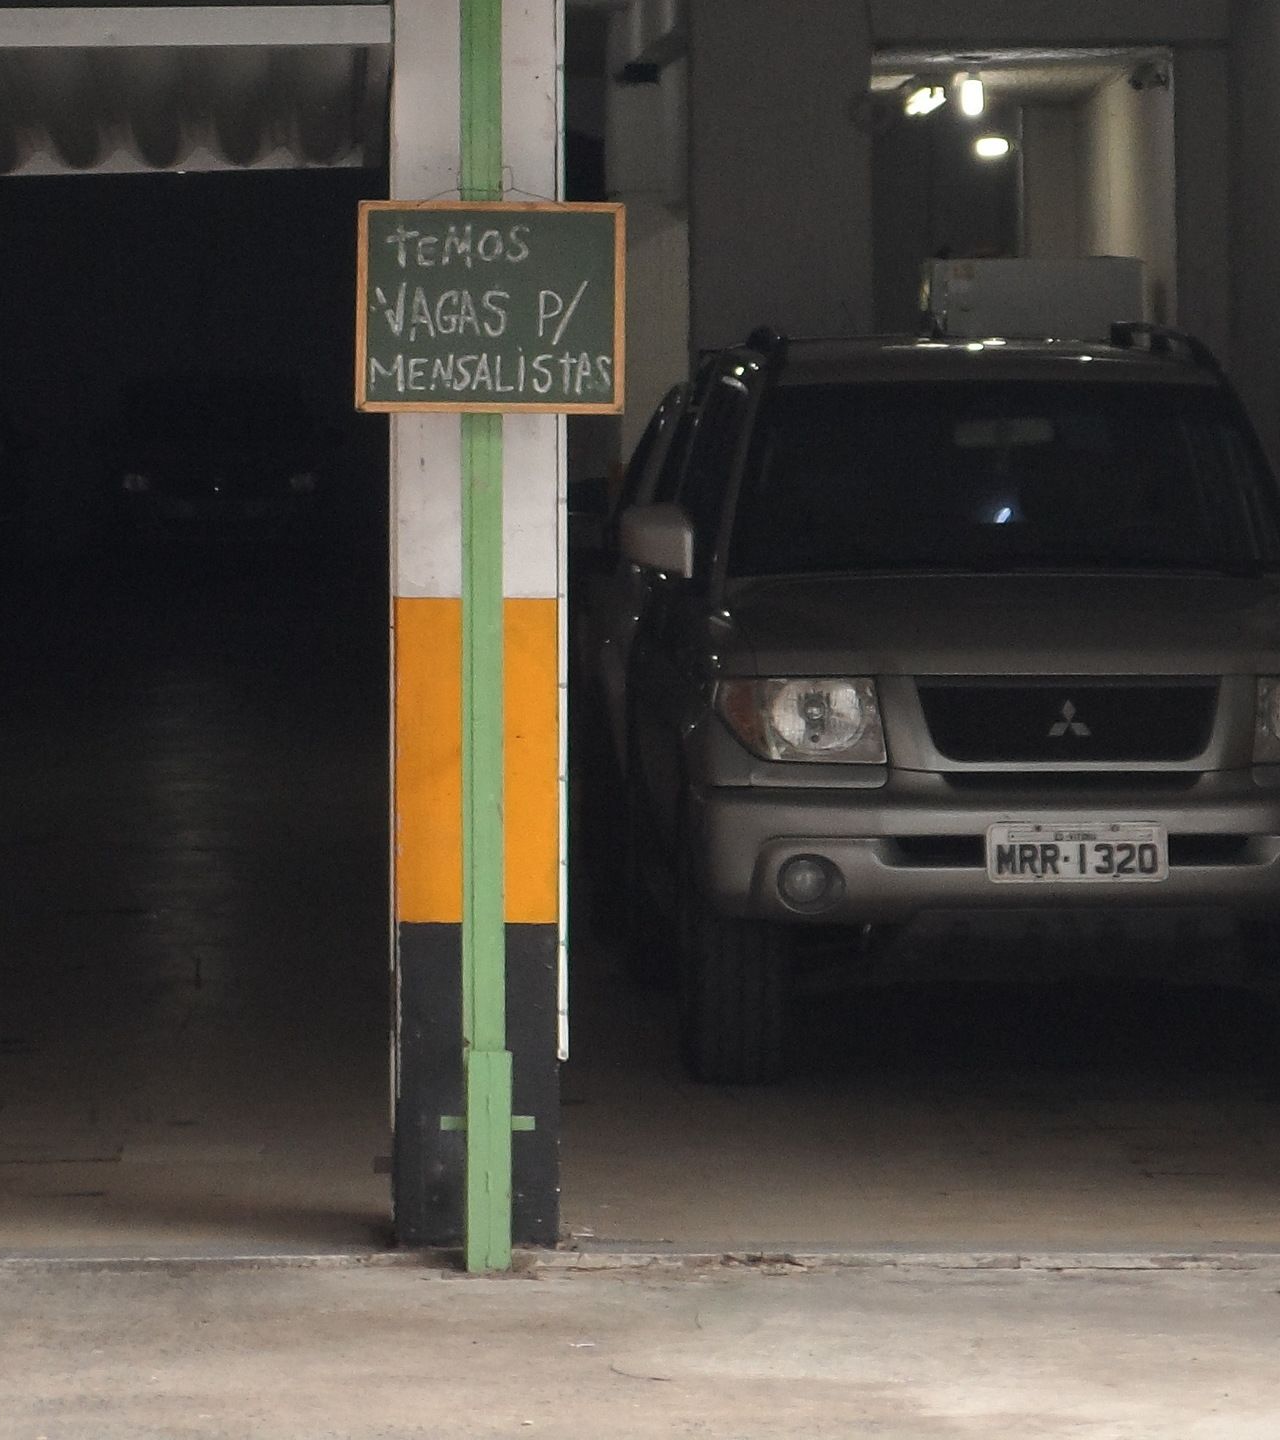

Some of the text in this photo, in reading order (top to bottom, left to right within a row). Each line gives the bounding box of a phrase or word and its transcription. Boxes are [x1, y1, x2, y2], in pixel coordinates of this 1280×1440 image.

[386, 224, 530, 268] TEMOS
[373, 280, 589, 346] VAGAS P/
